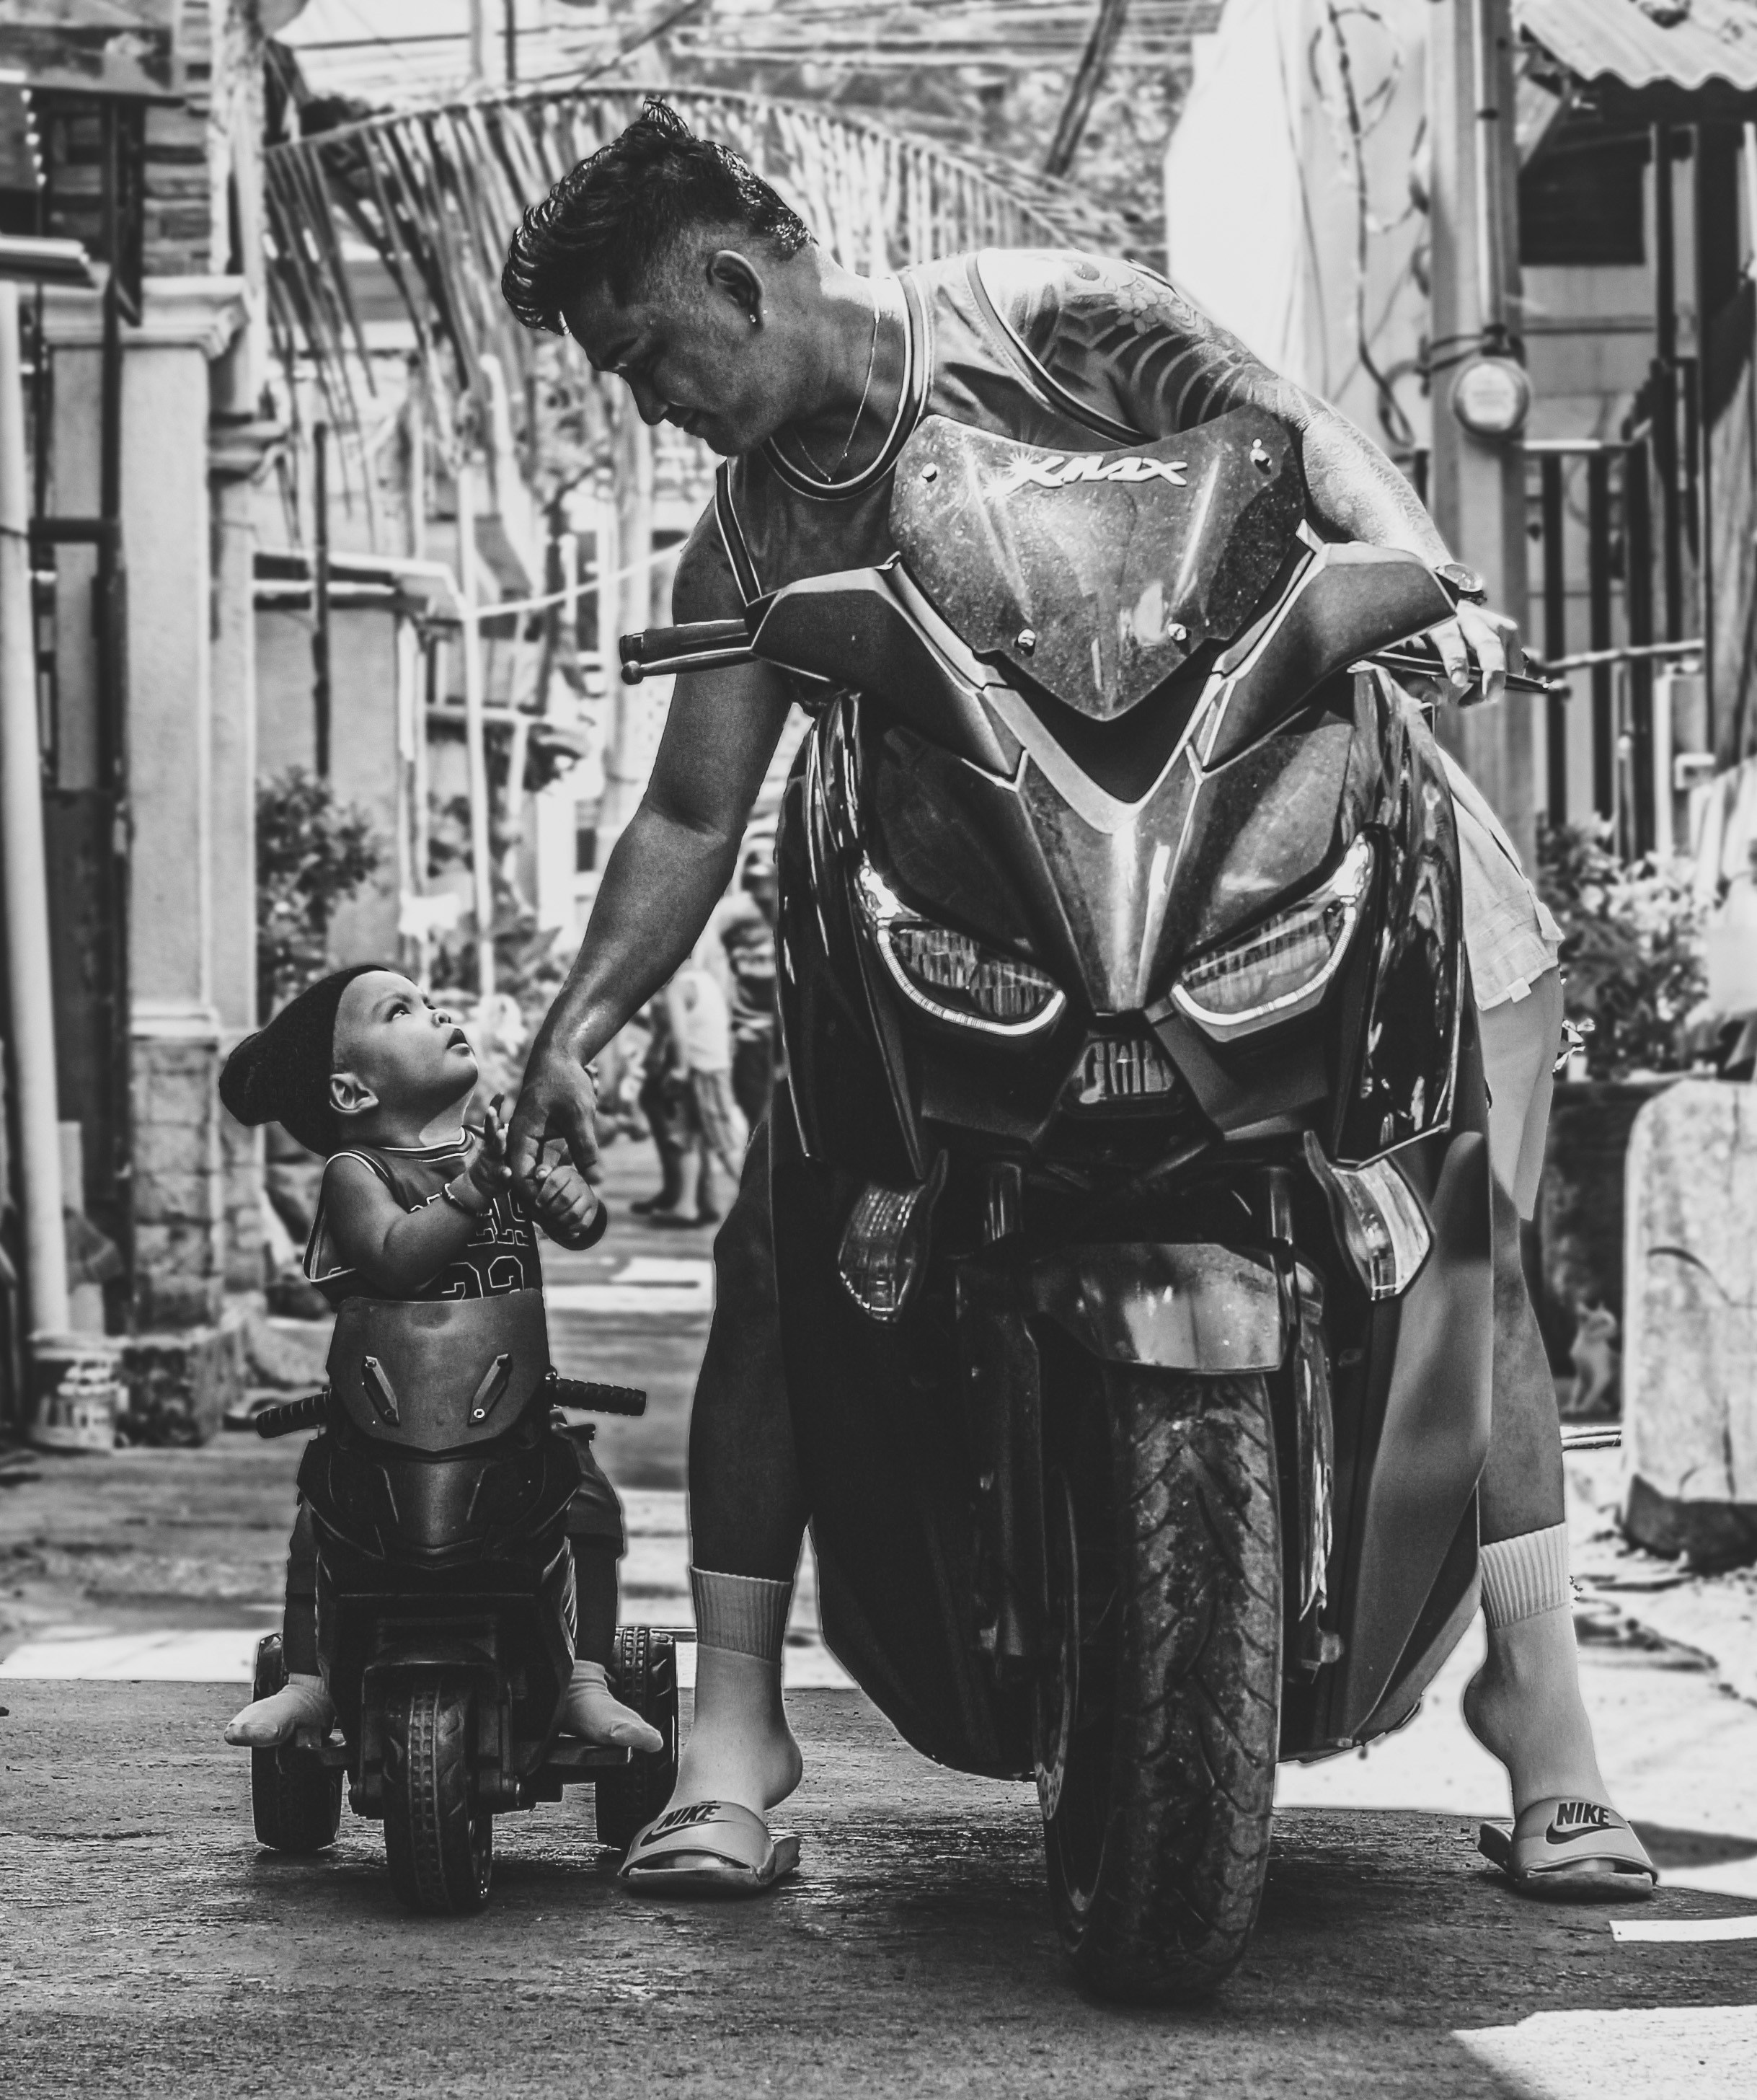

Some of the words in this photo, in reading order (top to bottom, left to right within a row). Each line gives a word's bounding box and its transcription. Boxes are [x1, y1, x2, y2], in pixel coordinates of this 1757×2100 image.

[985, 455, 1188, 495] XMAX
[656, 1804, 721, 1830] NIKE
[1556, 1802, 1609, 1827] NIKE
